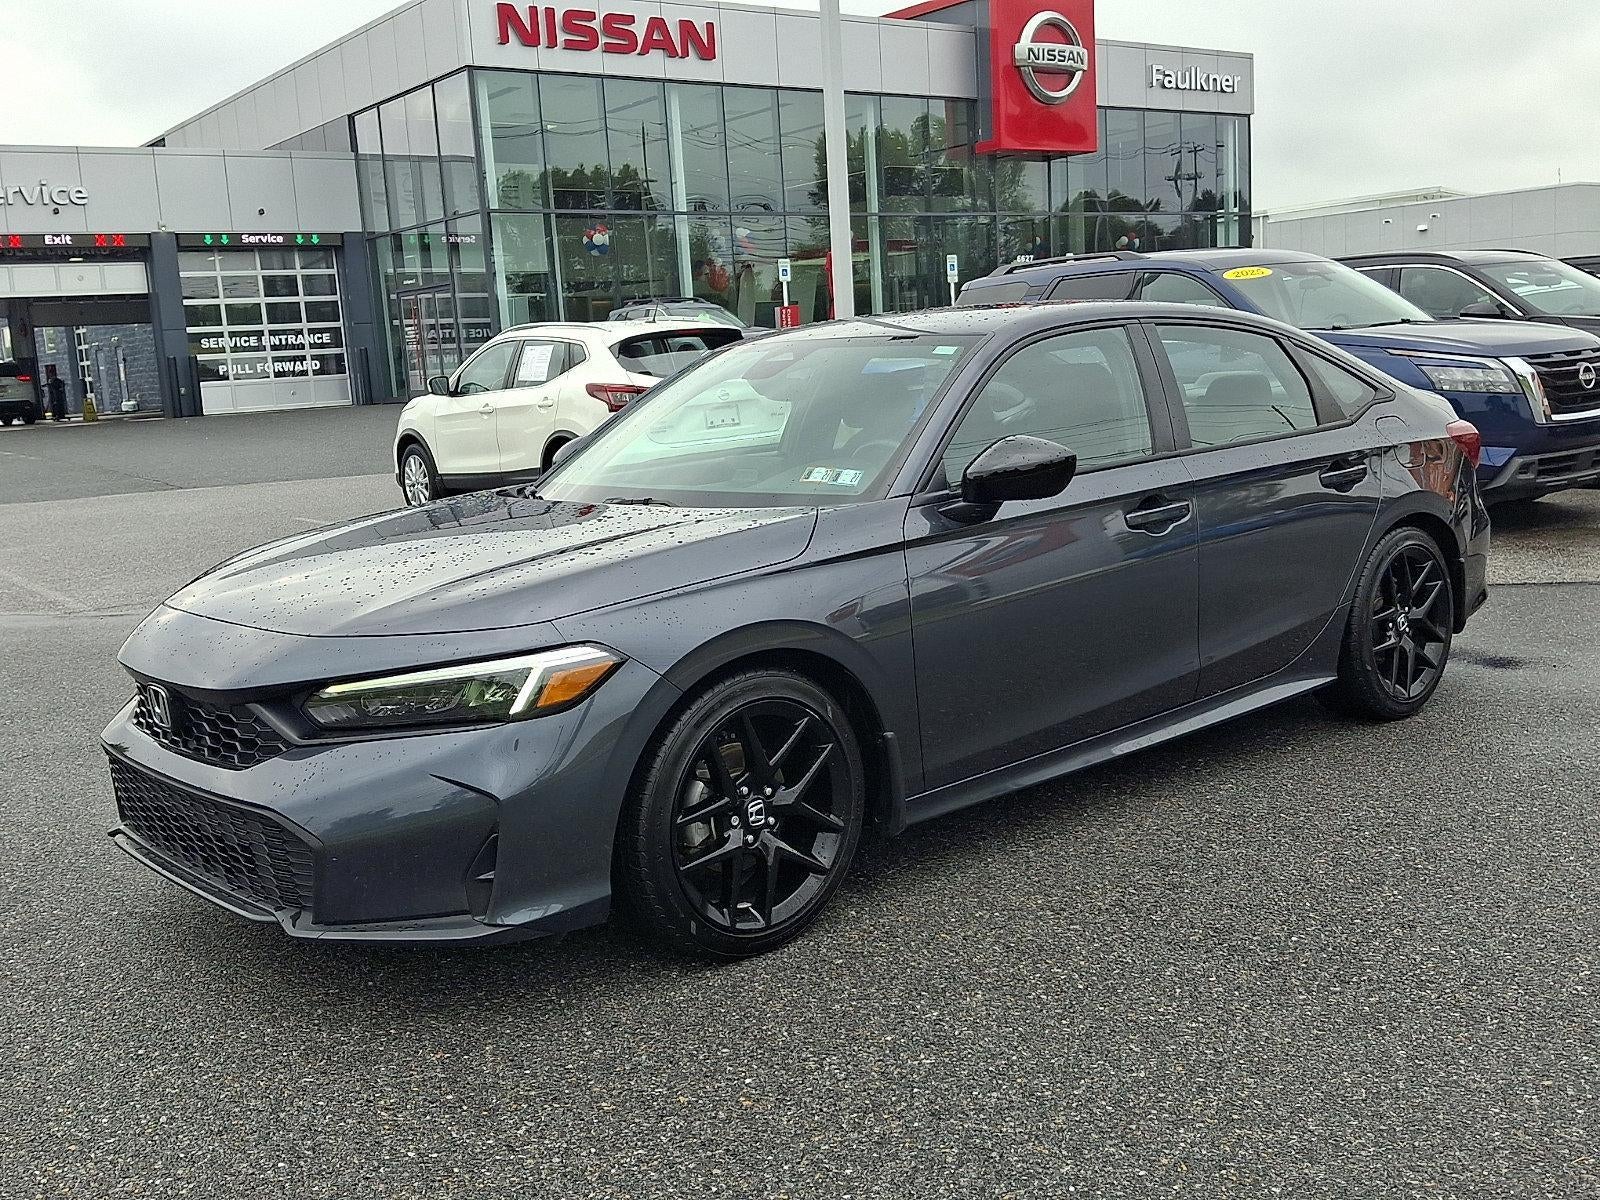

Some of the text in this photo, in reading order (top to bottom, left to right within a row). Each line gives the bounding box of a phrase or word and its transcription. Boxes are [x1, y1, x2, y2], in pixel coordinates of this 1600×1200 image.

[497, 2, 716, 60] NISSAN
[1027, 47, 1085, 65] NISSAN
[1151, 64, 1241, 93] Faulkner
[0, 179, 88, 206] rvice
[44, 234, 72, 245] Exit
[241, 234, 284, 243] Service
[1232, 269, 1265, 278] 2025
[201, 336, 258, 348] SERVICE
